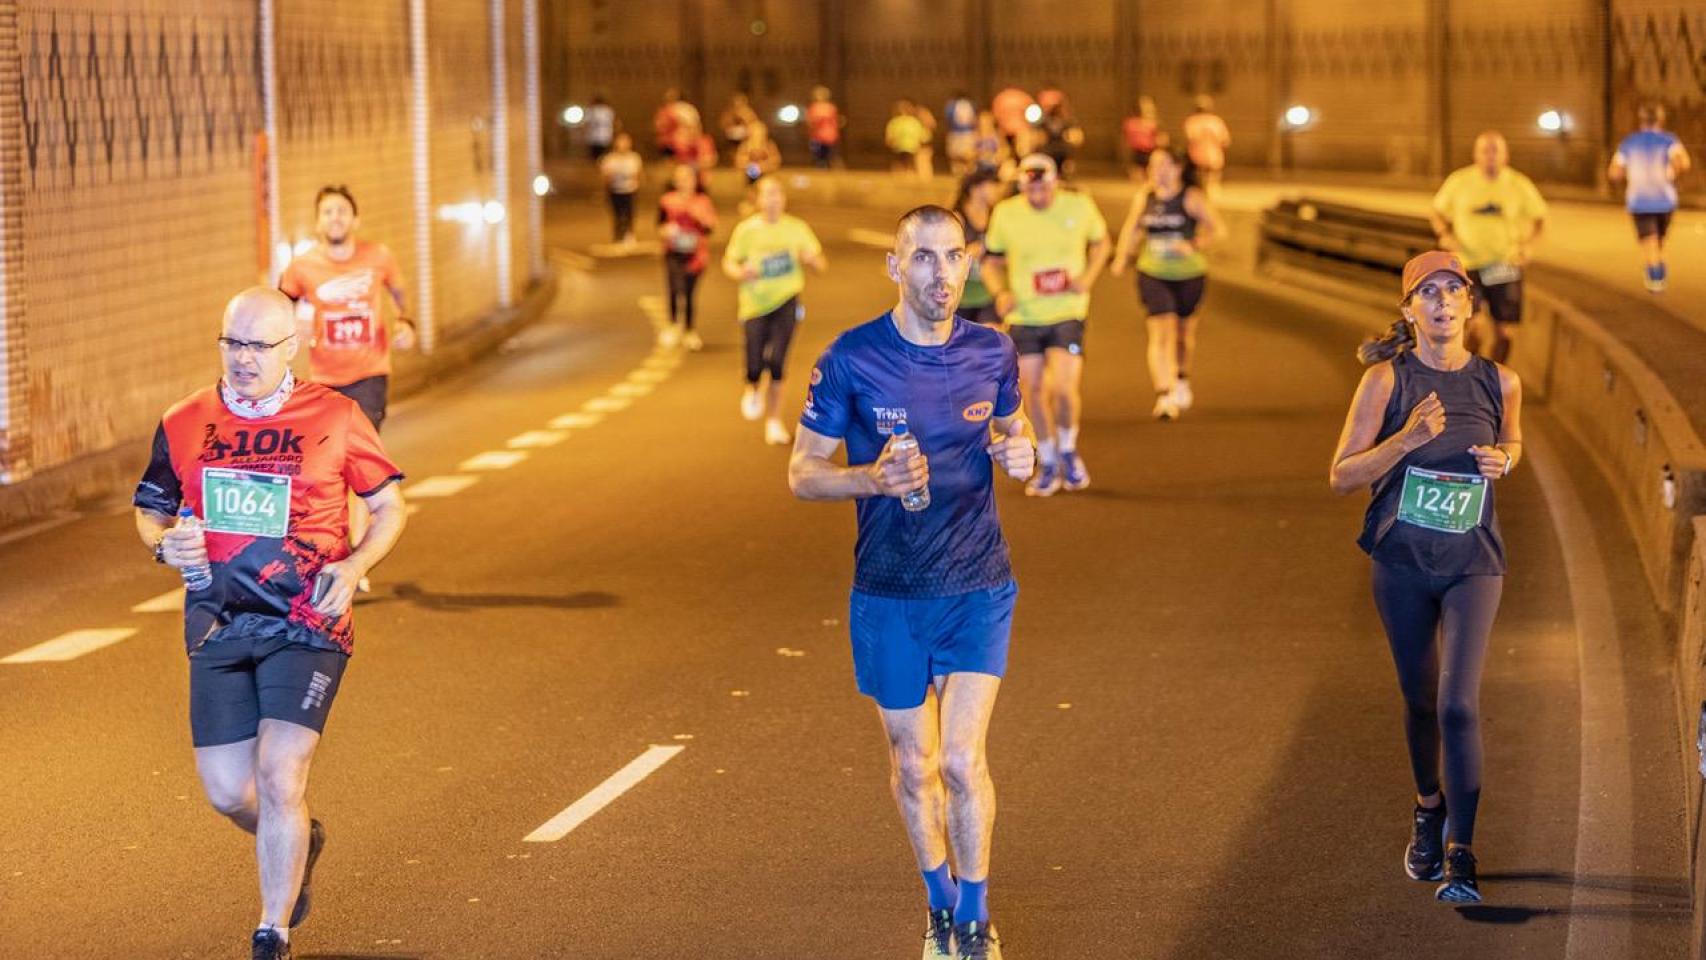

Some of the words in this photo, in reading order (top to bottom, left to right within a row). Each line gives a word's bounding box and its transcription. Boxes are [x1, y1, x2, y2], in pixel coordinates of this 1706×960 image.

[231, 428, 305, 457] 10k
[230, 454, 304, 465] ALEJANDRO
[214, 487, 277, 517] 1064
[1416, 485, 1472, 515] 1247
